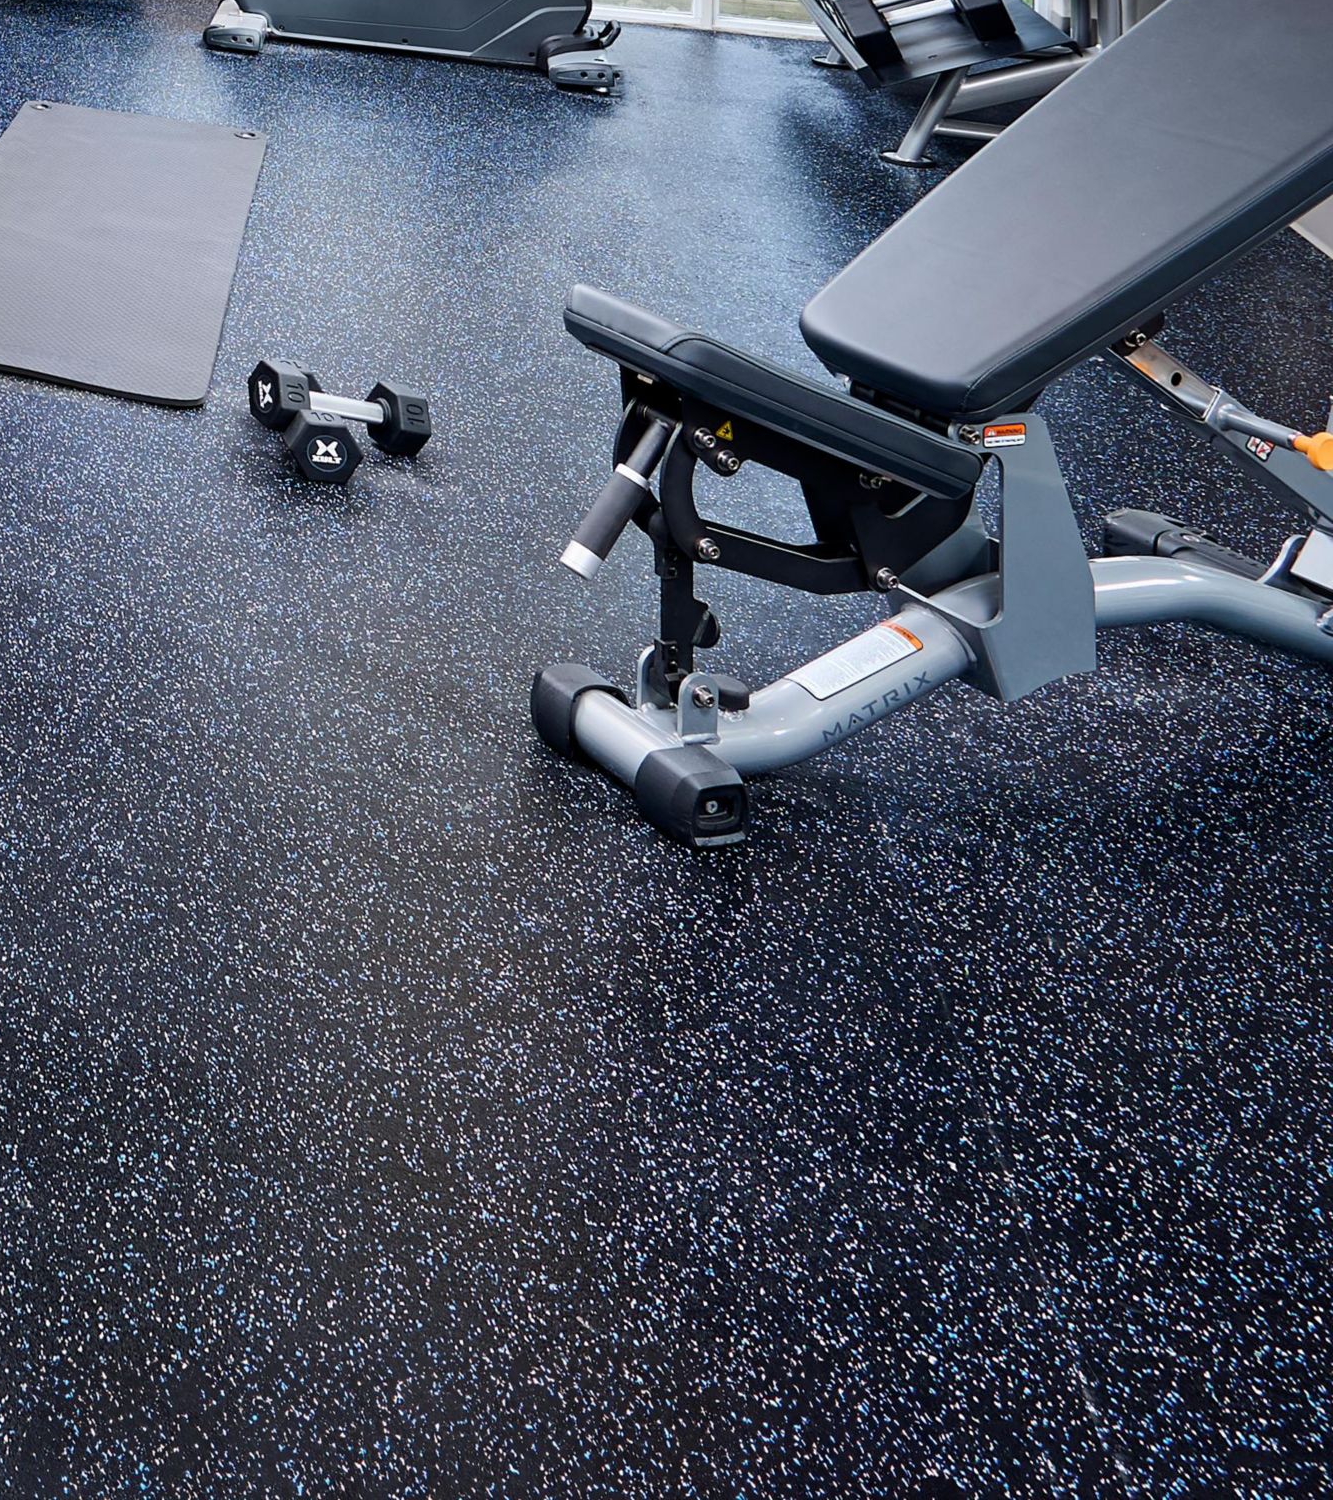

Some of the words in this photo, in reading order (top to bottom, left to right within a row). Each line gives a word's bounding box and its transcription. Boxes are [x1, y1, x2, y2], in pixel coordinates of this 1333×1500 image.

[286, 383, 306, 403] 10
[310, 411, 335, 422] 10
[406, 403, 425, 426] 10
[821, 671, 933, 743] MATRIX
